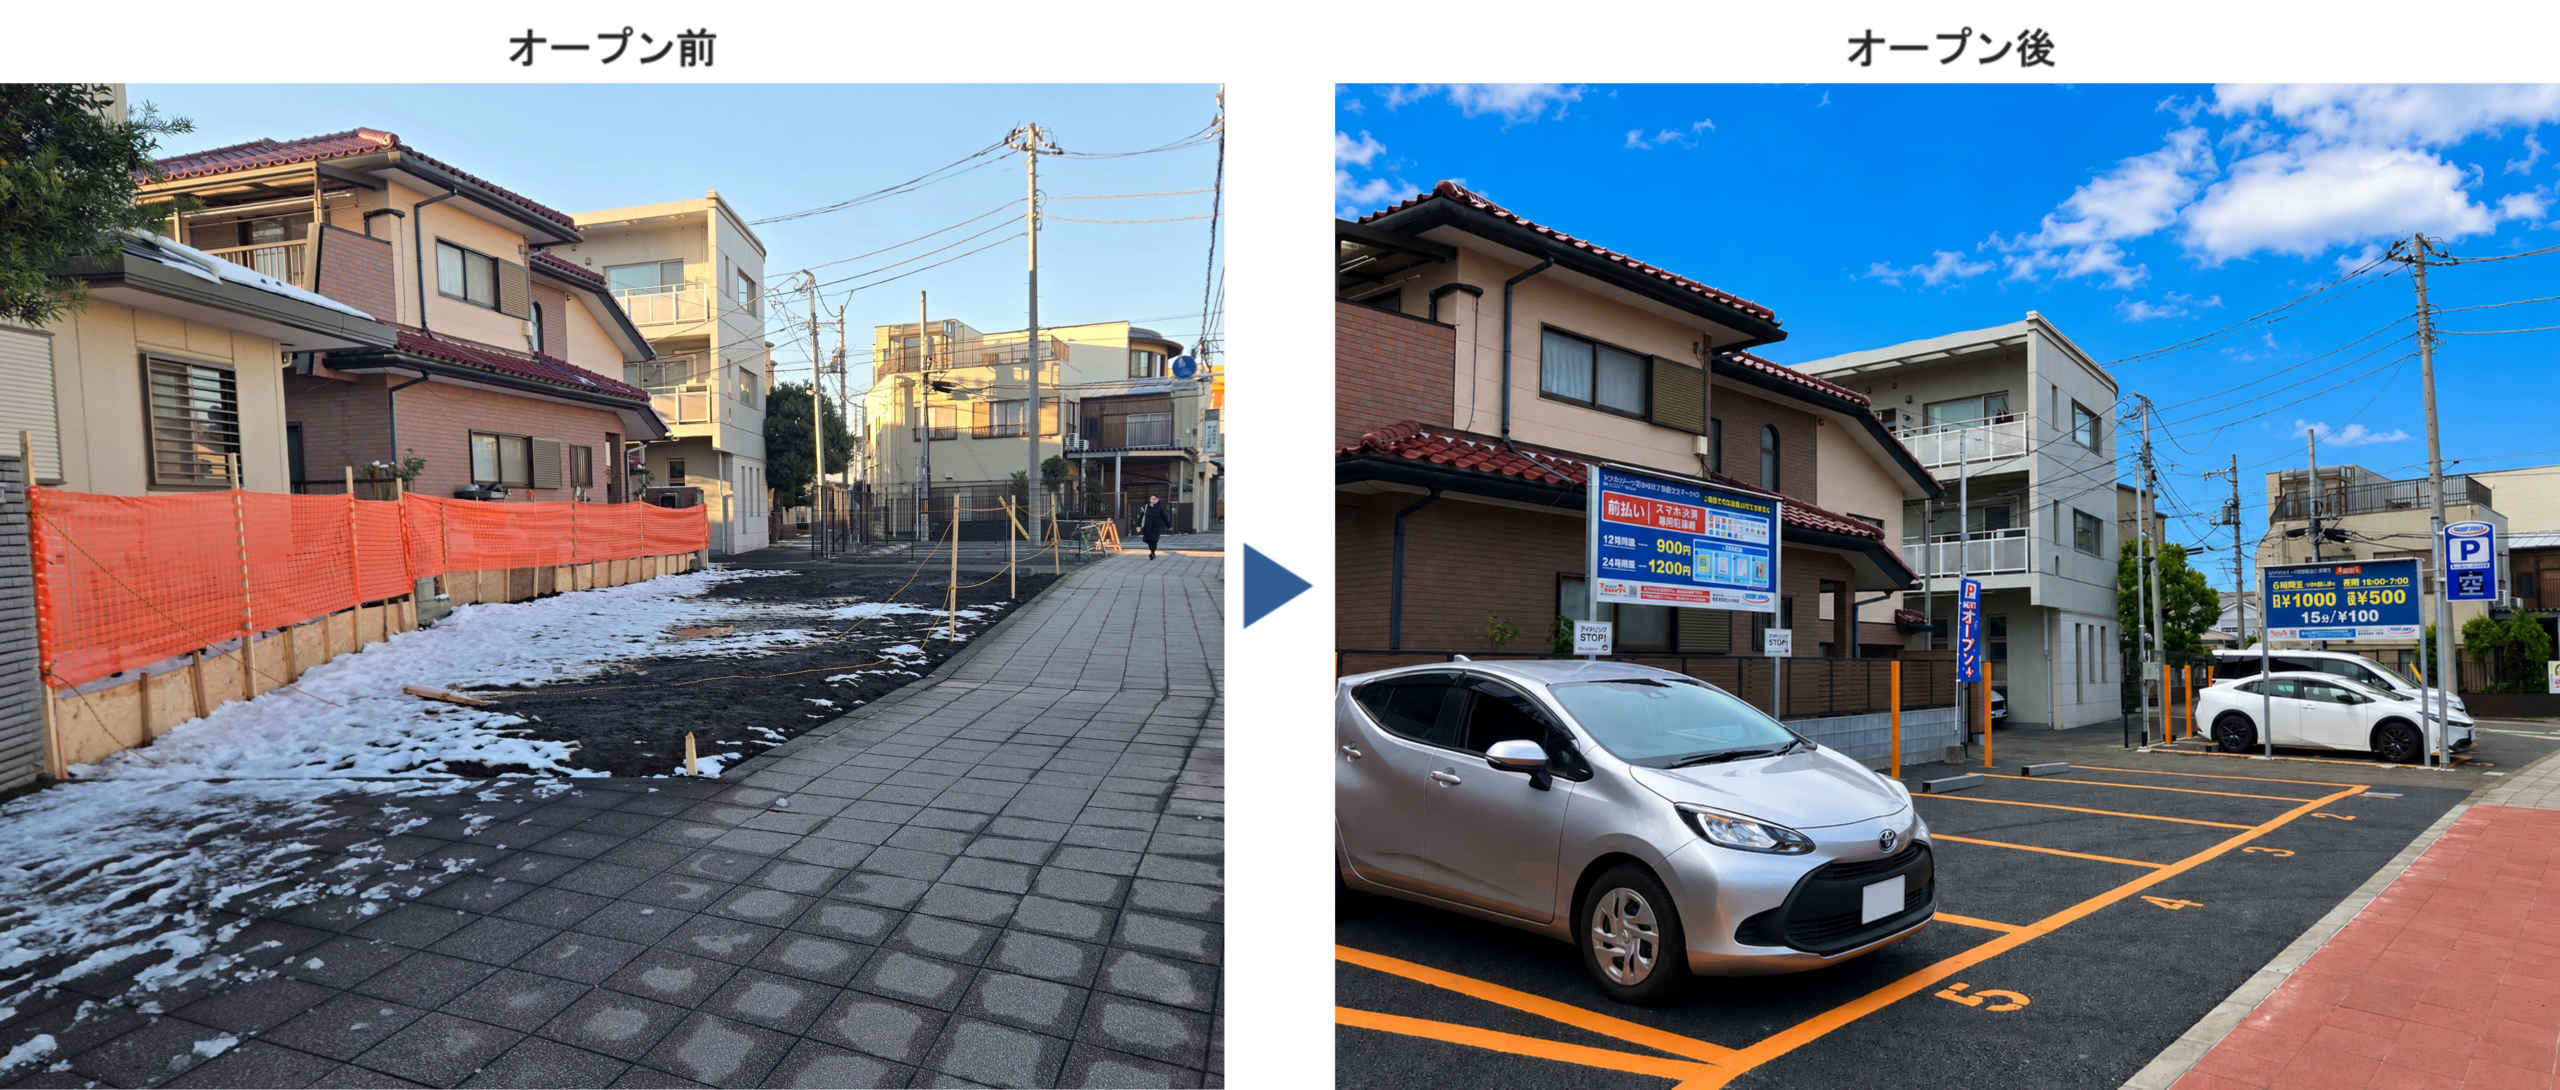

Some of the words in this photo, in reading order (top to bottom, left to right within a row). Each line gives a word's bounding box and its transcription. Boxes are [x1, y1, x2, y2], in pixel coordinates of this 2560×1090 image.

[1608, 499, 1645, 518] 前払い
[1657, 538, 1691, 556] 900円
[2460, 540, 2481, 561] P
[1648, 559, 1691, 577] 1200円
[1966, 584, 1975, 598] P
[1580, 633, 1607, 642] STOP!
[2140, 895, 2204, 911] 4
[1934, 982, 2031, 1012] 5
